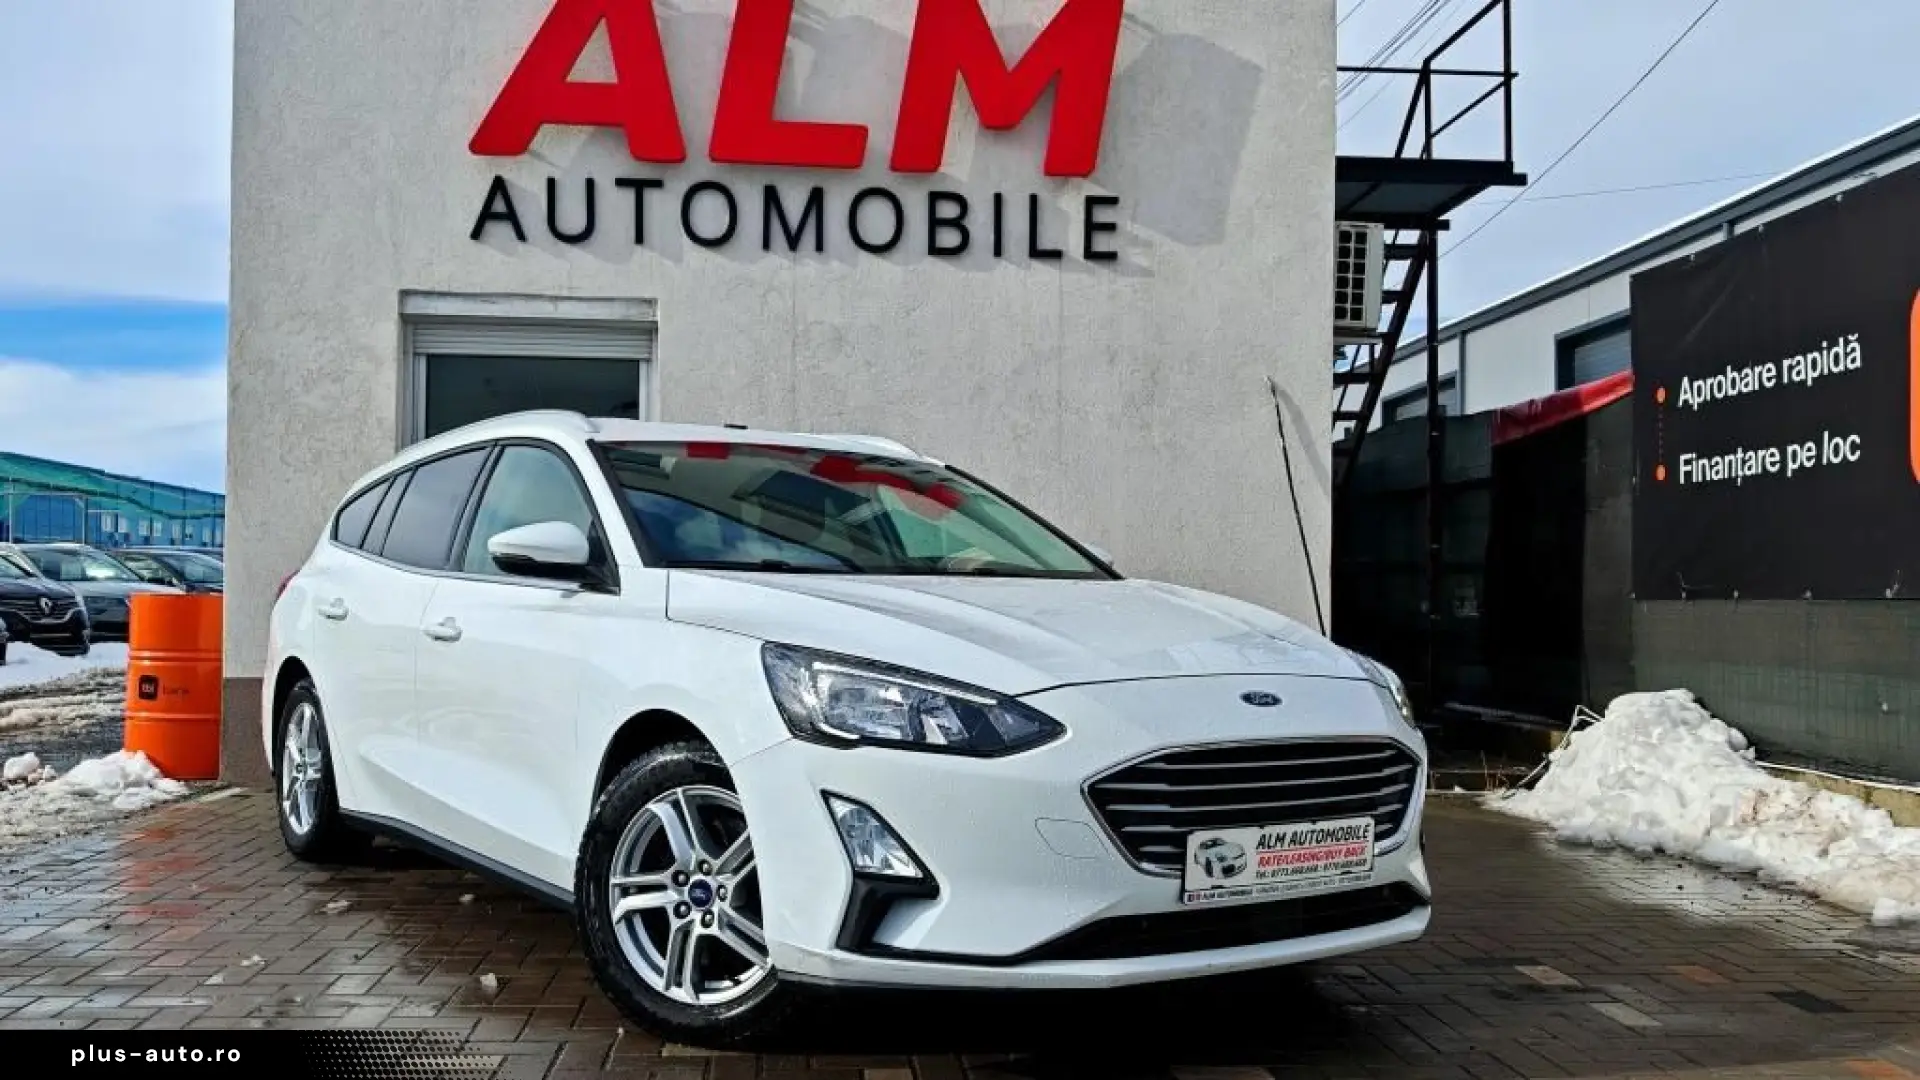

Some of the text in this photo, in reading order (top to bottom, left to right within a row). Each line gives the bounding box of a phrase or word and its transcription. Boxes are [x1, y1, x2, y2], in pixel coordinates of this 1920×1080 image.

[469, 0, 1124, 178] ALM
[470, 175, 1119, 260] AUTOMOBILE
[1678, 333, 1861, 411] Aprobare rapidă
[1679, 431, 1861, 486] Finanțare pe loc
[1256, 823, 1371, 849] ALM AUTOMOBILE
